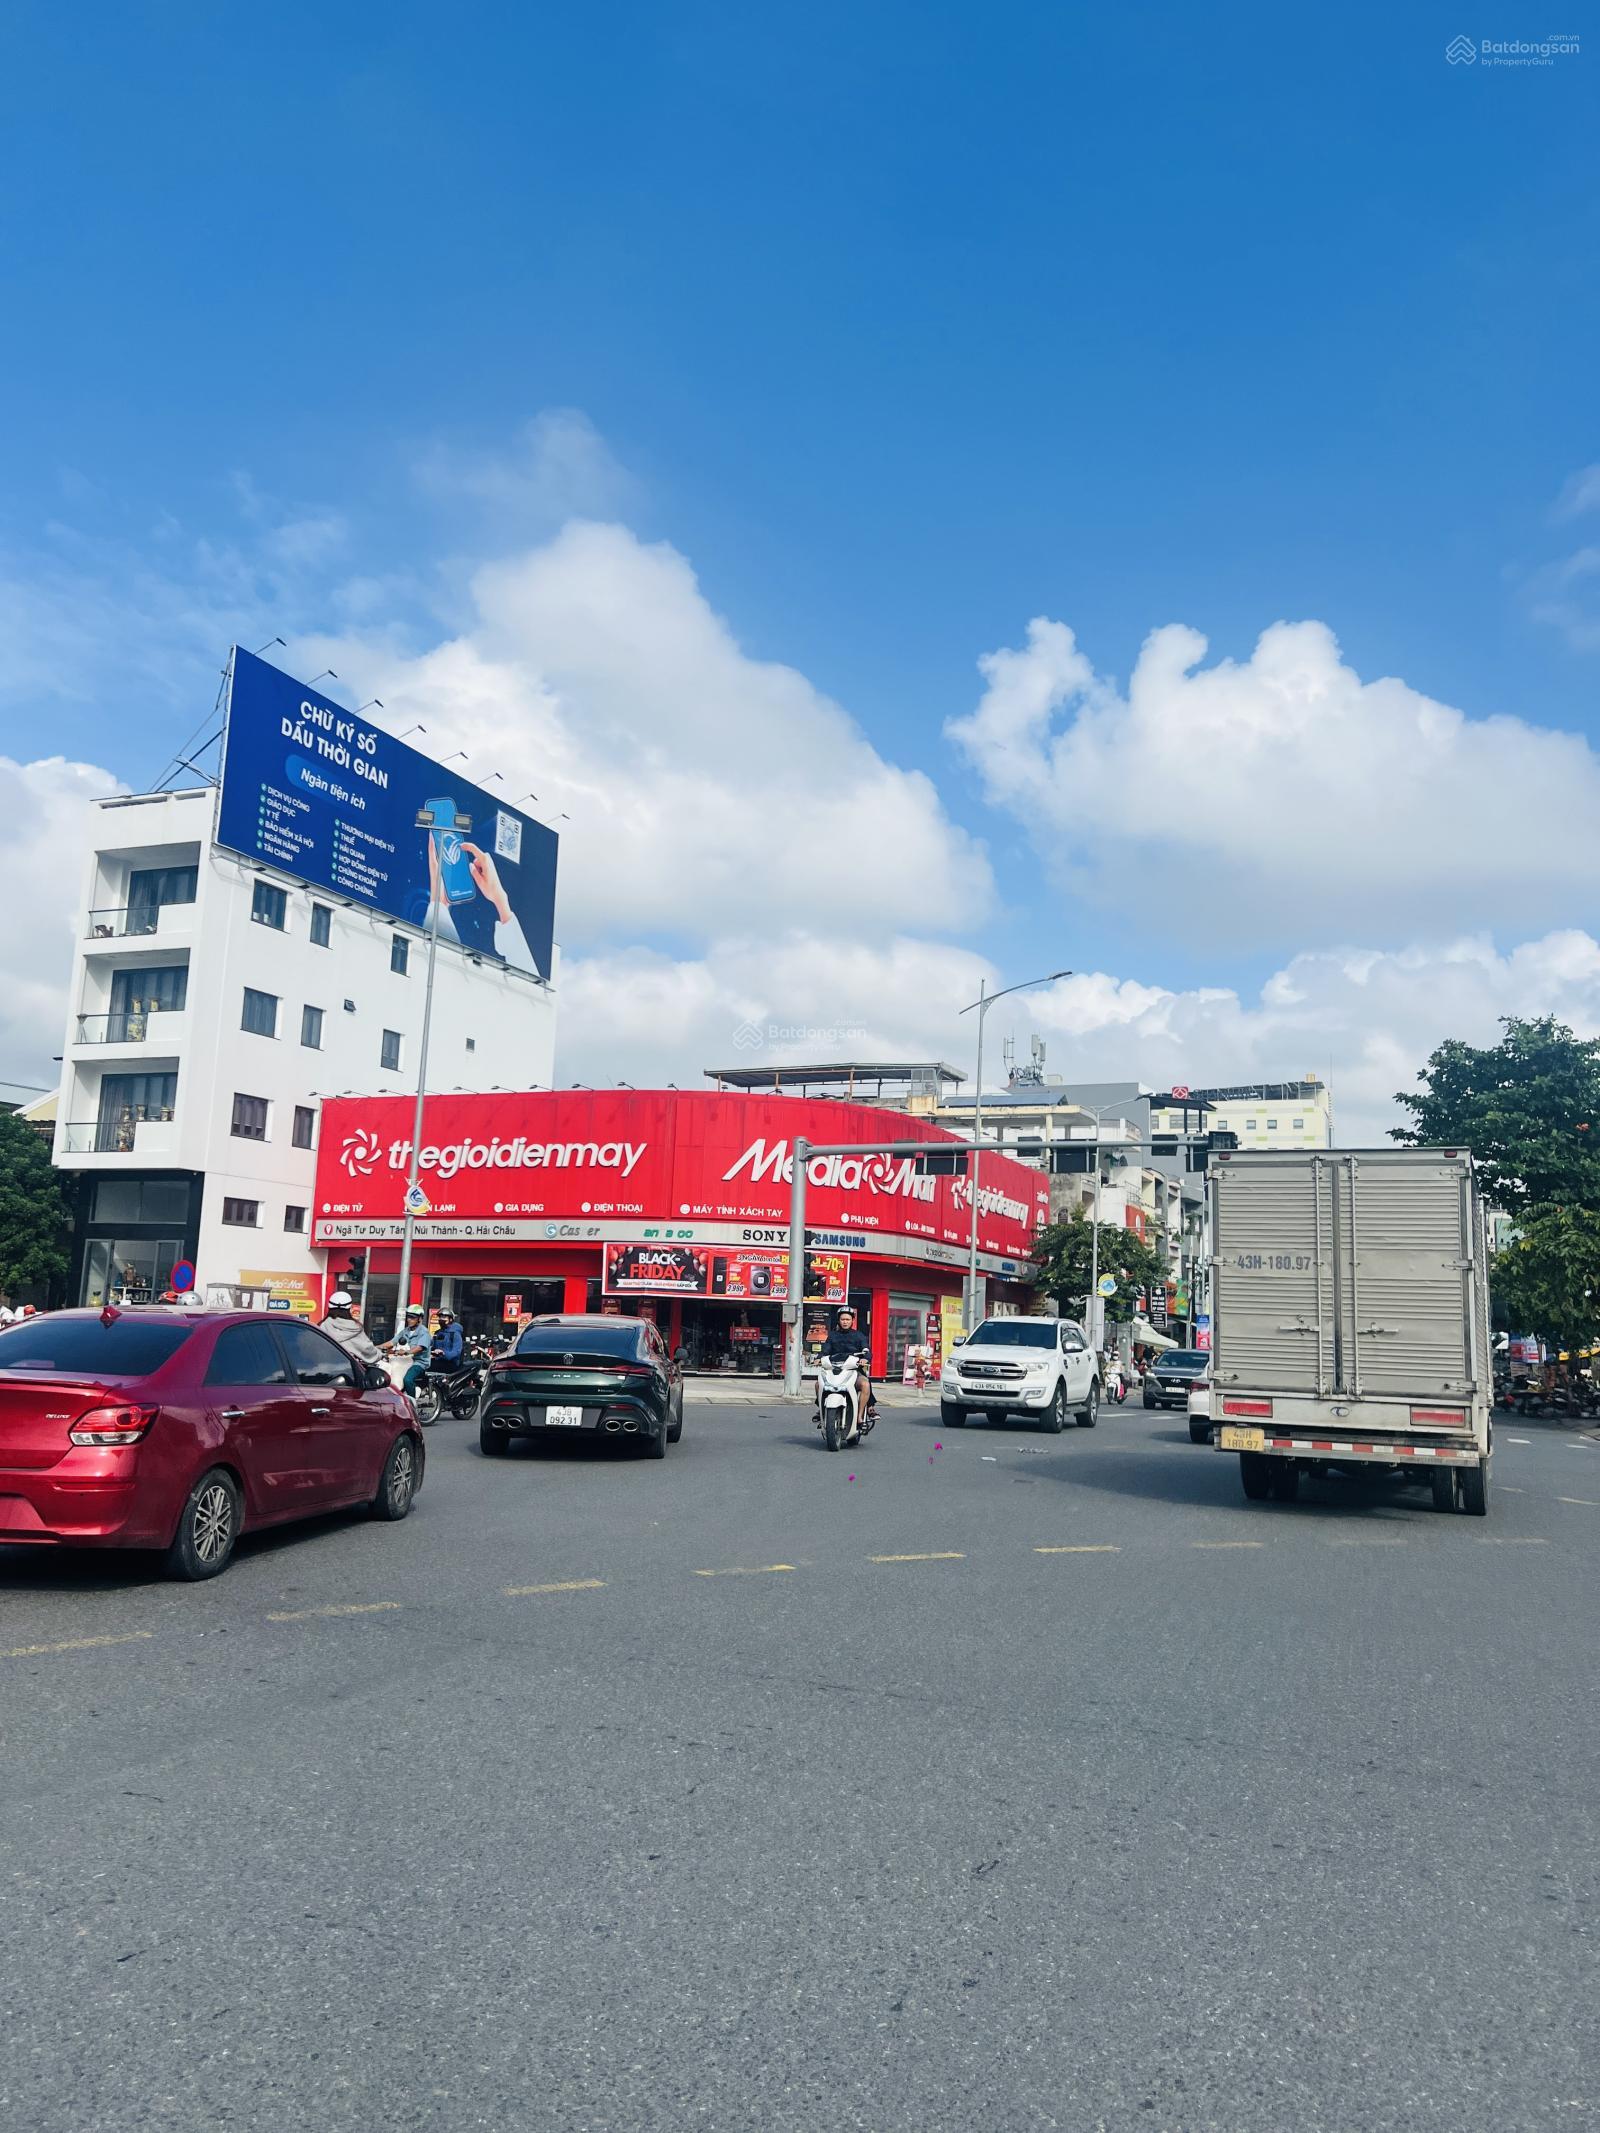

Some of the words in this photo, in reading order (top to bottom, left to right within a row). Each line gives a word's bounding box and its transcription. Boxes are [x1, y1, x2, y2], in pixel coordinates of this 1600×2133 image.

[336, 720, 355, 743] KÝ
[357, 733, 377, 755] SỐ
[281, 717, 313, 748] DẤU
[317, 736, 350, 769] THỜI
[353, 758, 388, 789] GIAN
[301, 768, 328, 791] Ngàn
[330, 783, 349, 801] tiện
[350, 793, 366, 810] ích
[388, 1136, 647, 1178] thegioidienmay
[722, 1138, 864, 1191] Media
[333, 1203, 350, 1213] ĐIỆN
[434, 1204, 456, 1214] LẠNH
[505, 1204, 519, 1212] GIA
[521, 1204, 544, 1213] DỤNG
[594, 1203, 613, 1213] ĐIỆN
[616, 1203, 643, 1213] THOẠI
[693, 1204, 712, 1215] MÁY
[716, 1204, 736, 1215] TÍNH
[739, 1205, 764, 1217] XÁCH
[767, 1208, 783, 1217] TAY
[850, 1215, 864, 1226] PHỤ
[864, 1216, 879, 1226] KIỆN
[336, 1225, 352, 1236] Ngã
[354, 1226, 366, 1235] Tư
[369, 1226, 386, 1237] Duy
[390, 1225, 405, 1235] Tân
[415, 1225, 428, 1235] Núi
[432, 1225, 457, 1235] Thành
[477, 1225, 490, 1235] Hải
[493, 1225, 516, 1235] Châu
[742, 1229, 787, 1243] SONY
[815, 1233, 866, 1248] SAMSUNG
[1237, 1254, 1311, 1271] 43H-180.97
[630, 1263, 686, 1280] FRIDAY
